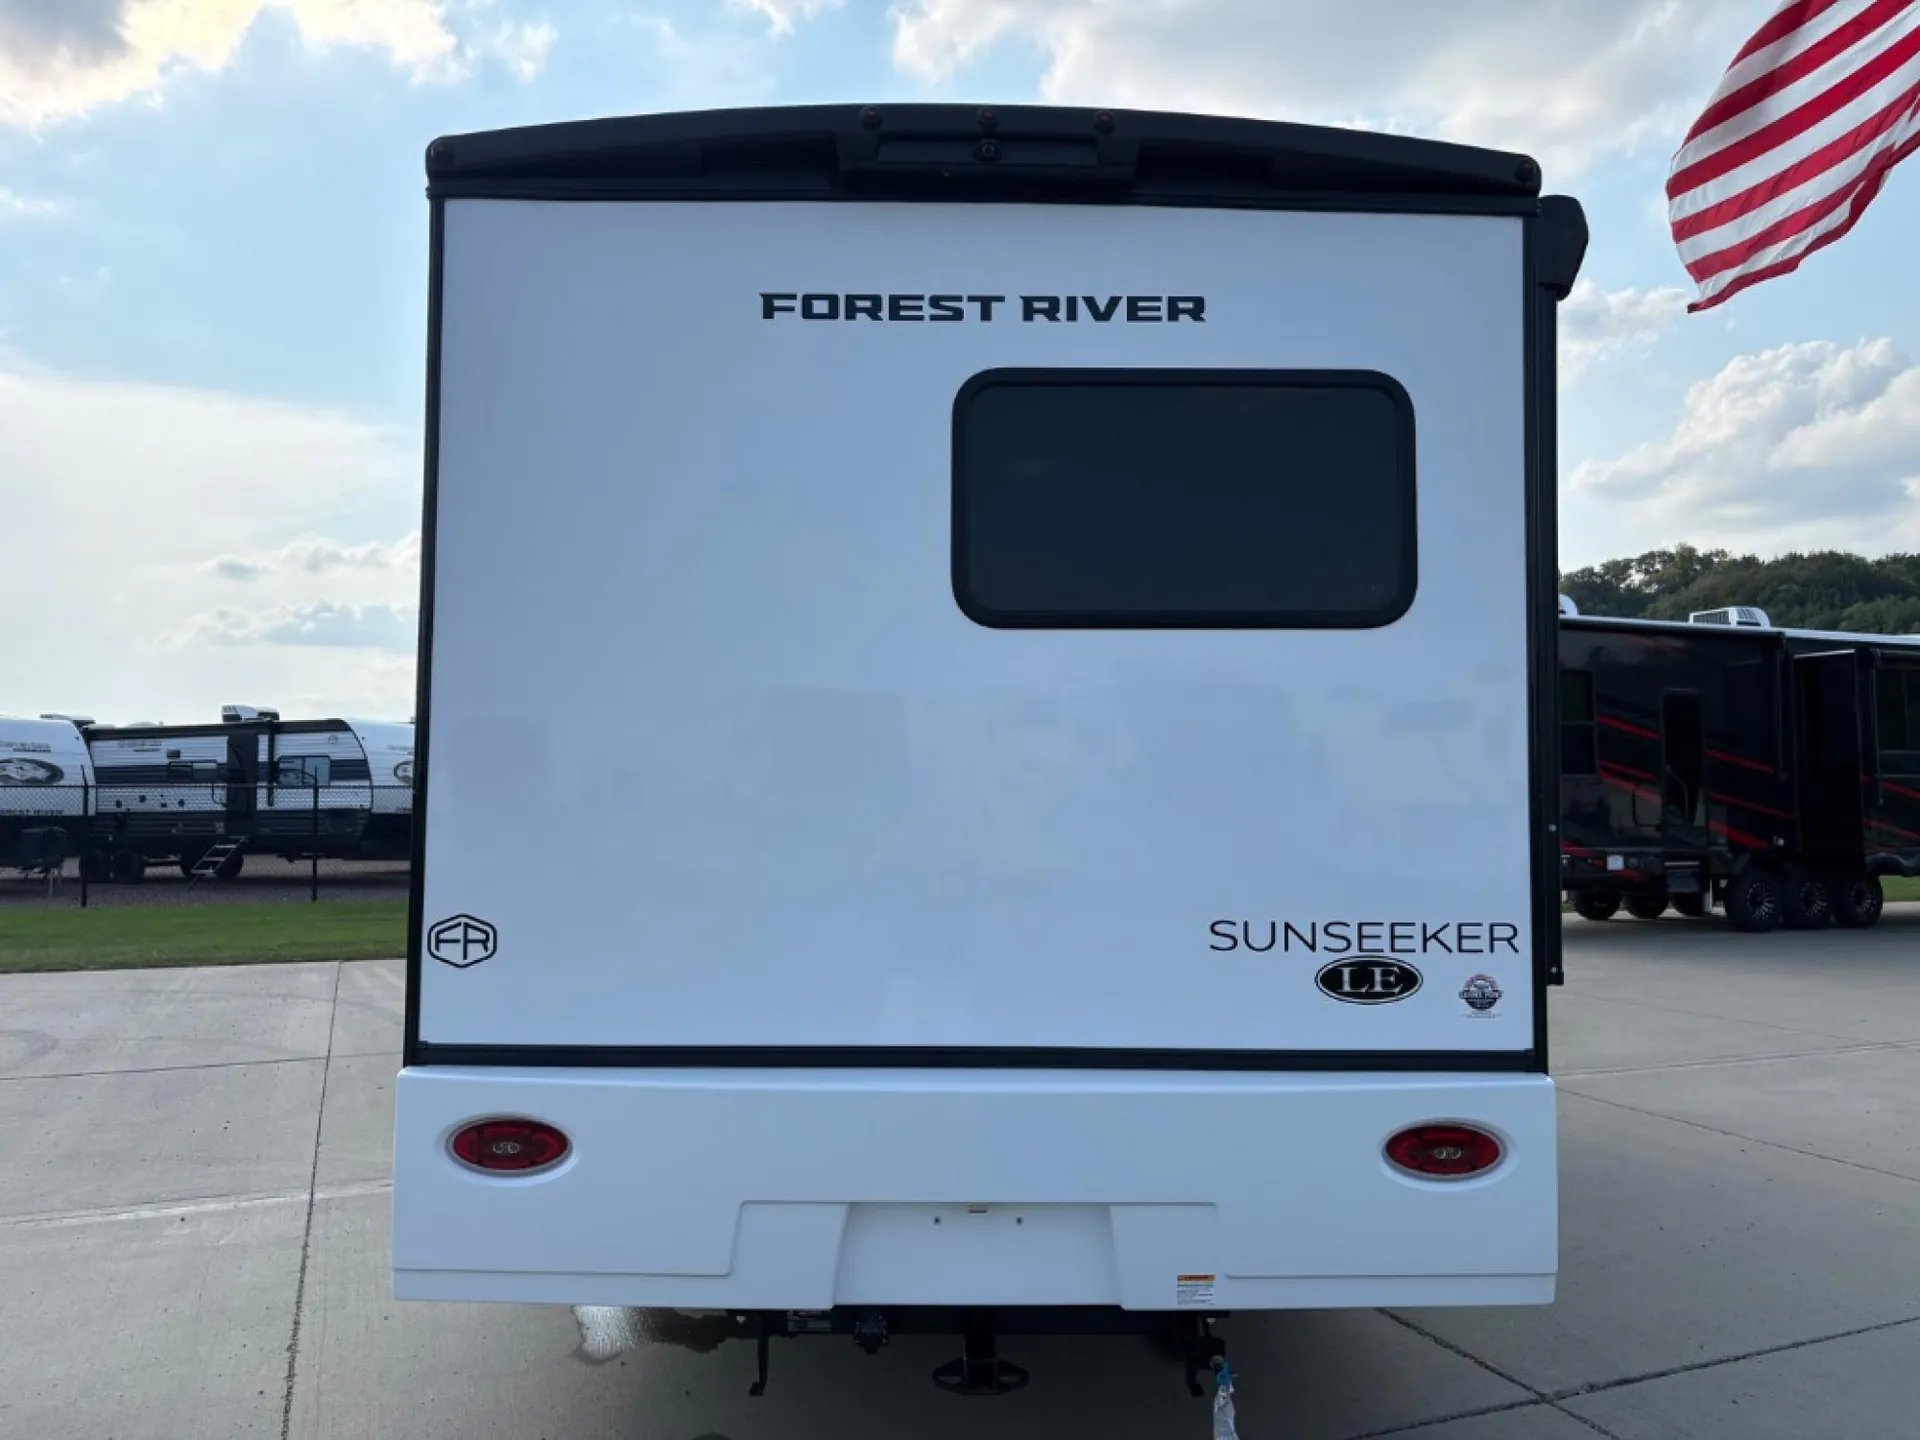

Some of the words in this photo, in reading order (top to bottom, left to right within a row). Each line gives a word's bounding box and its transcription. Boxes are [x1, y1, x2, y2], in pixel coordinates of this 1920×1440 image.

[760, 293, 1005, 321] FOREST
[1020, 295, 1206, 323] RIVER
[435, 921, 490, 960] FR
[1210, 920, 1519, 953] SUNSEEKER
[1338, 966, 1404, 994] LE
